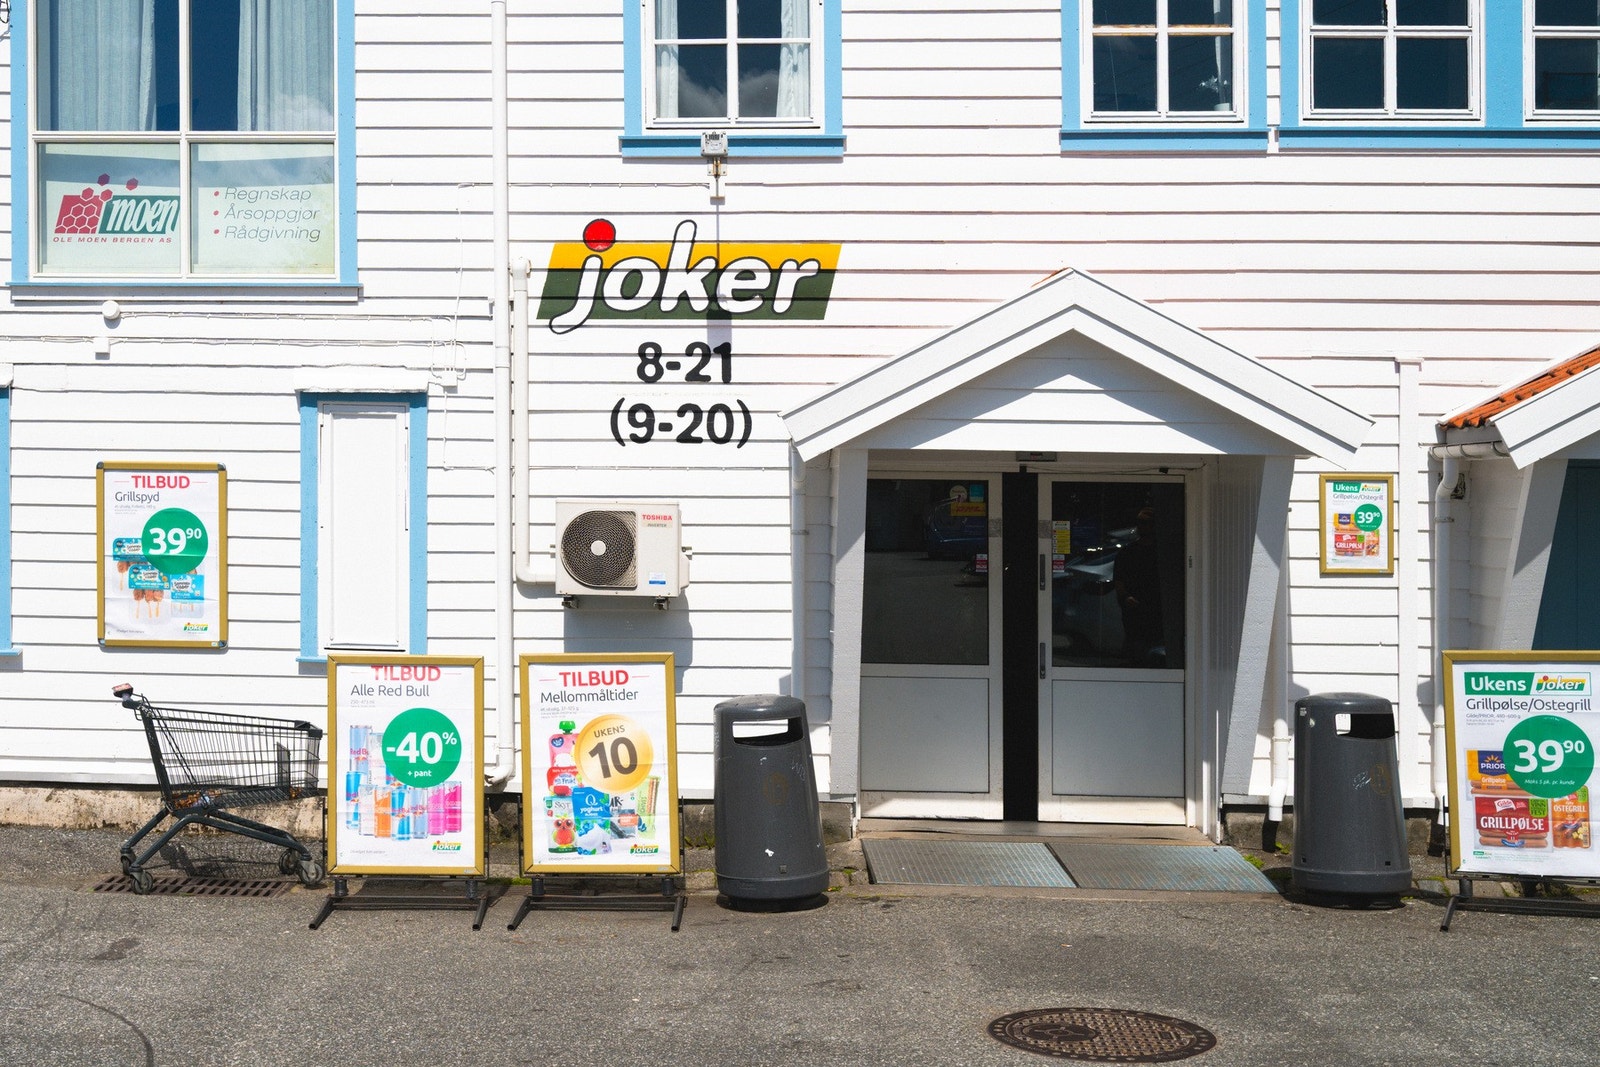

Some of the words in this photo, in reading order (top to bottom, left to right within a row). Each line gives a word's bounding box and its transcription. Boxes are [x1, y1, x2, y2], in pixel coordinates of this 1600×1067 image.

[225, 187, 312, 203] Regnskap
[225, 206, 319, 222] Årsoppgjør
[225, 225, 321, 242] Rådgivning
[549, 218, 822, 334] joker
[636, 341, 732, 383] 8-21
[610, 397, 752, 449] (9-20)
[131, 475, 190, 489] TILBUD
[115, 491, 160, 504] Grillspyd
[371, 665, 441, 682] TILBUD
[559, 670, 629, 687] TILBUD
[350, 684, 375, 697] Alle
[379, 684, 402, 697] Red
[406, 684, 430, 697] Bull
[1471, 677, 1527, 691] Ukens
[1537, 675, 1583, 692] joker
[540, 688, 639, 704] Mellommåltider
[1466, 698, 1592, 713] Grillpølse/Ostegrill
[594, 725, 626, 738] UKENS
[588, 736, 638, 779] 10
[414, 769, 432, 778] pant
[1480, 762, 1506, 770] PRIOR
[585, 793, 598, 806] Q
[1480, 816, 1545, 831] GRILLPØLSE
[631, 844, 656, 855] joker
